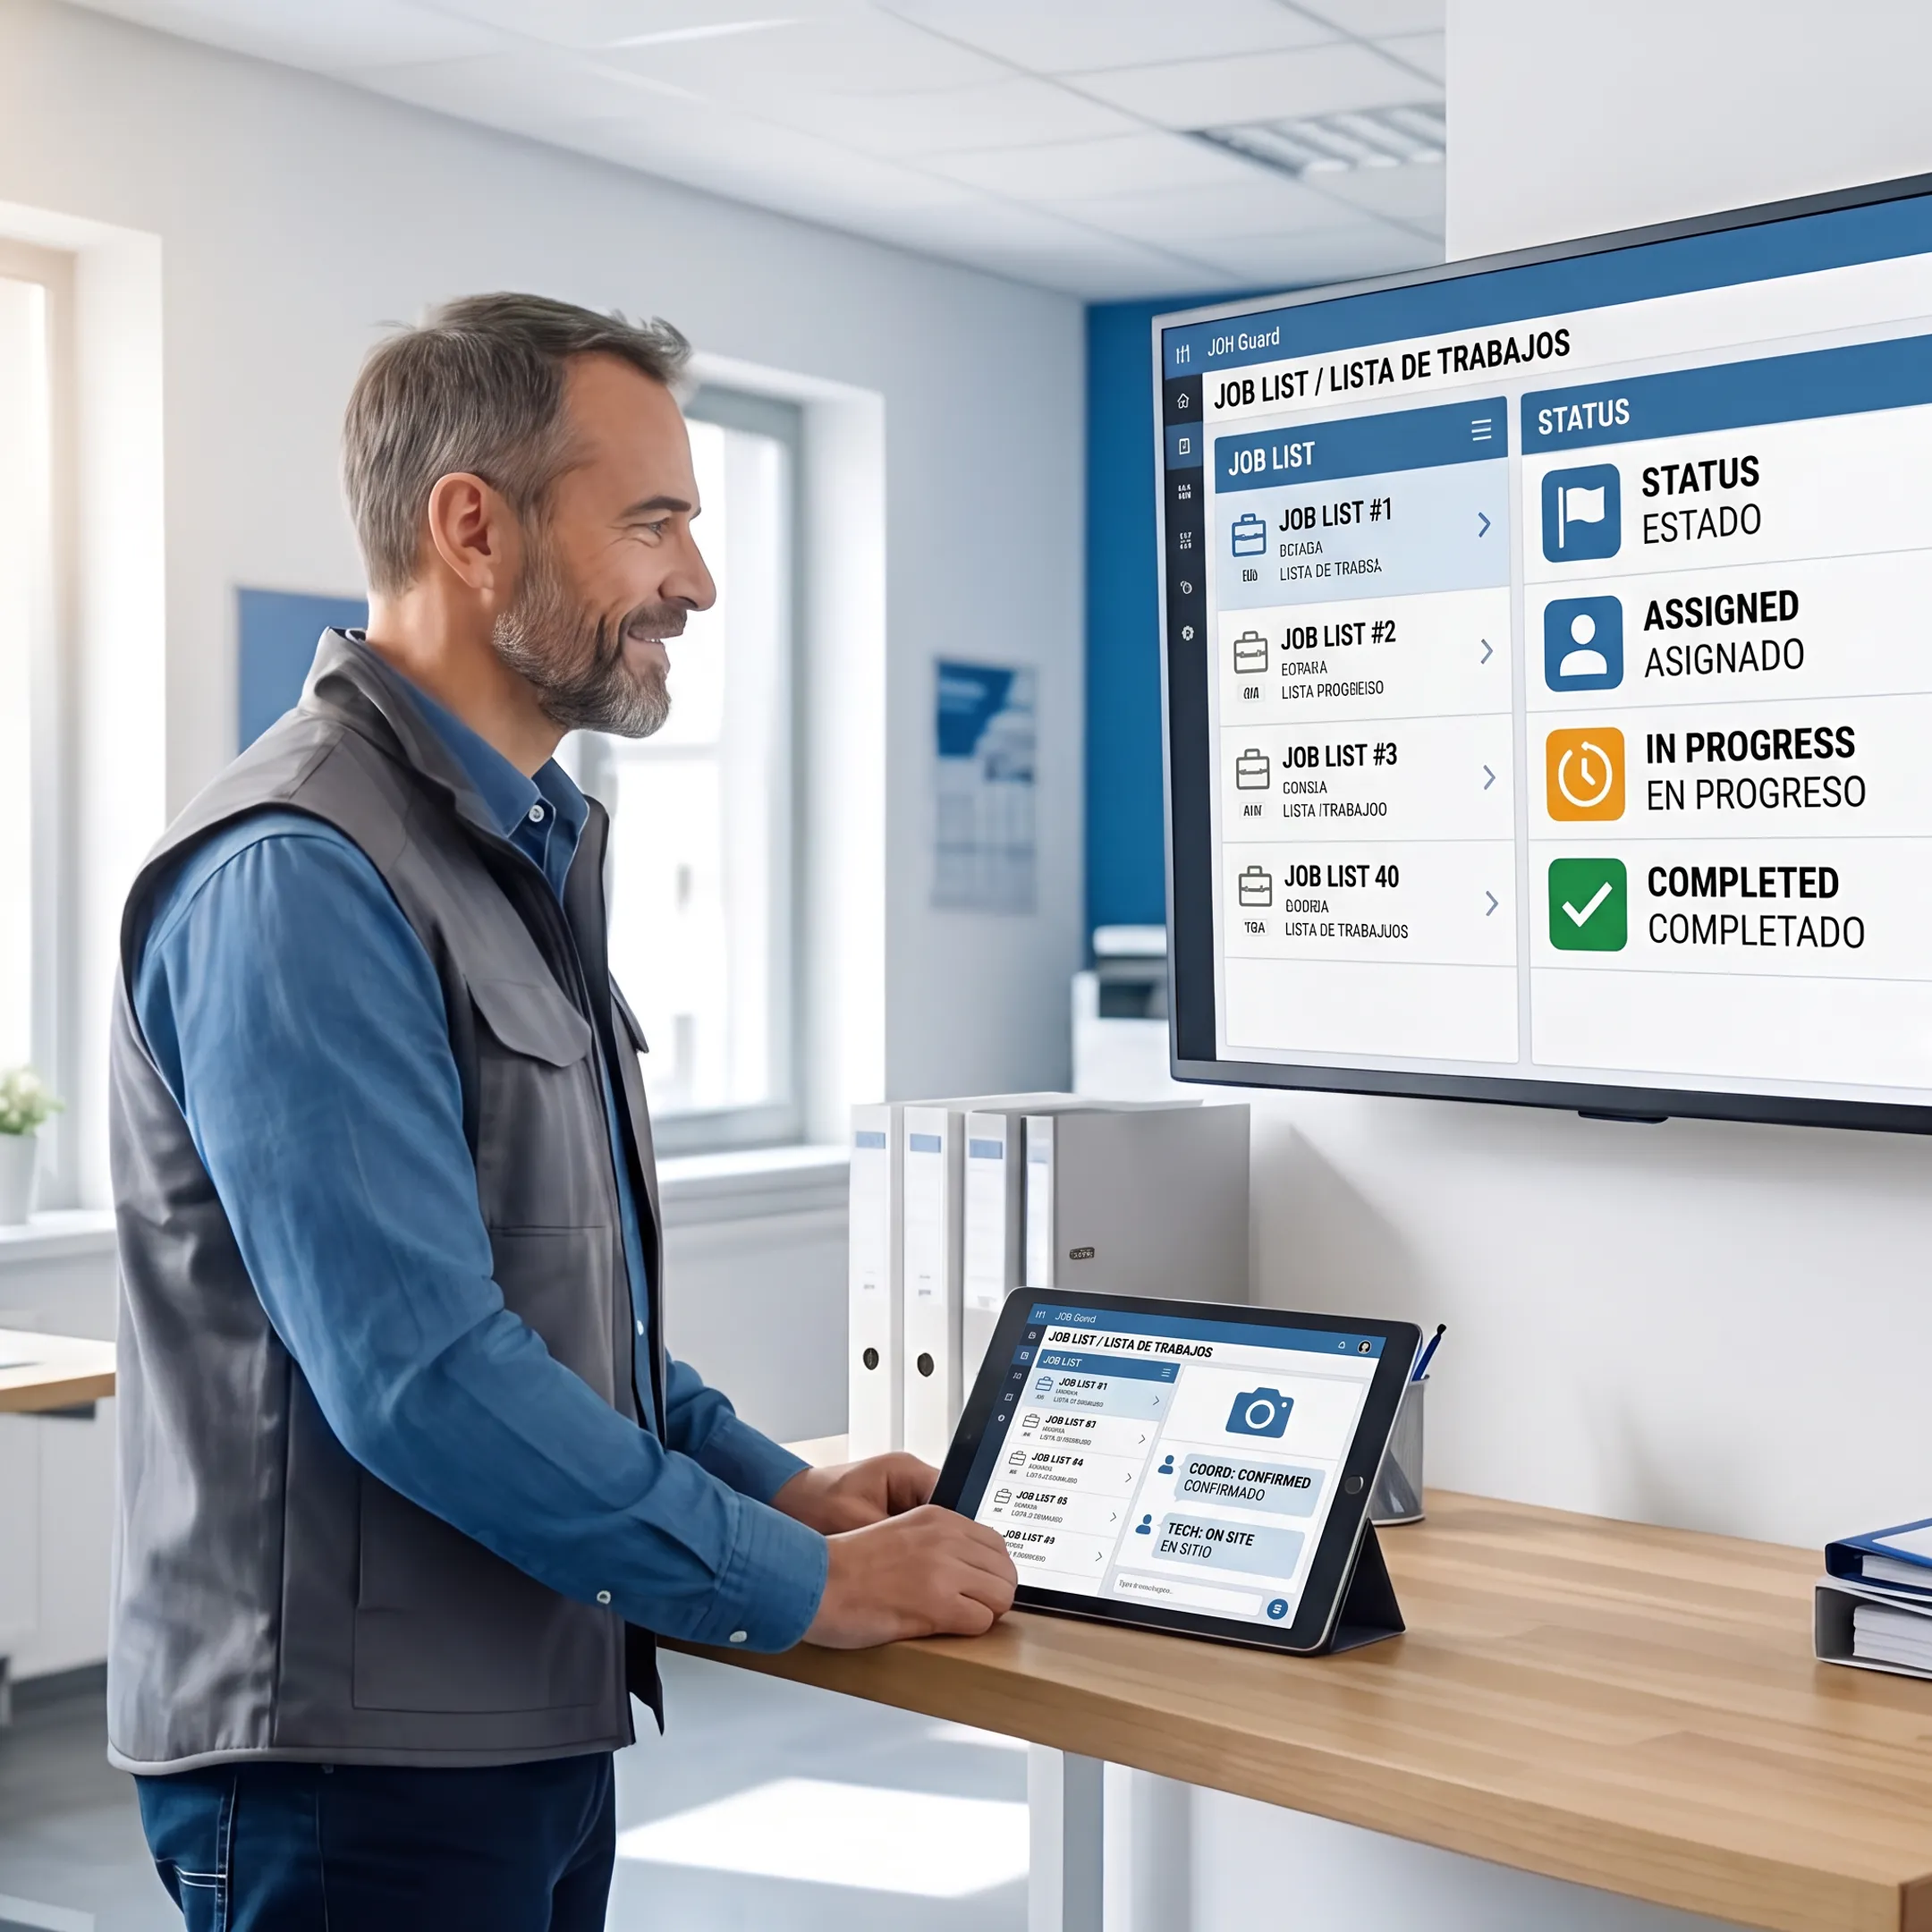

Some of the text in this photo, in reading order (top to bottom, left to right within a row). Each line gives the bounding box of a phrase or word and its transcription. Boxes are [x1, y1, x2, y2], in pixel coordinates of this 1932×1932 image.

[1238, 326, 1280, 351] Guard
[1214, 329, 1571, 409] JOB LIST / LISTA DE TRABAJOS
[1538, 398, 1631, 436] STATUS
[1228, 441, 1316, 476] JOB LIST
[1642, 454, 1760, 497] STATUS
[1279, 497, 1392, 532] JOB LIST #1
[1643, 503, 1761, 545] ESTADO
[1280, 565, 1312, 580] LISTA
[1316, 563, 1331, 578] DE
[1643, 589, 1800, 631] ASSIGNED
[1281, 620, 1396, 650] JOB LIST #2
[1644, 638, 1805, 678] ASIGNADO
[1282, 684, 1314, 699] LISTA
[1283, 742, 1397, 768] JOB LIST #3
[1647, 726, 1855, 764] IN PROGRESS
[1648, 775, 1866, 810] EN PROGRESO
[1284, 803, 1316, 818] LISTA
[1284, 865, 1399, 887] JOB LIST 40
[1648, 866, 1840, 899] COMPLETED
[1285, 922, 1317, 936] LISTA
[1320, 923, 1335, 936] DE
[1648, 912, 1865, 949] COMPLETADO
[1055, 1310, 1072, 1321] JOB
[1048, 1331, 1214, 1358] JOB LIST / LISTA DE TRABAJOS
[1043, 1355, 1082, 1368] JOB LIST
[1059, 1377, 1076, 1387] JOB
[1077, 1379, 1097, 1389] LIST
[1046, 1415, 1064, 1425] JOB
[1064, 1417, 1085, 1427] LIST
[1031, 1453, 1050, 1462] JOB
[1051, 1454, 1072, 1465] LIST
[1189, 1462, 1311, 1489] COORD: CONFIRMED
[1016, 1491, 1035, 1501] JOB
[1183, 1479, 1266, 1501] CONFIRMADO
[1003, 1530, 1021, 1540] JOB
[1021, 1531, 1044, 1543] LIST
[1167, 1522, 1255, 1546] TECH: ON SITE
[1160, 1539, 1212, 1558] EN SITIO
